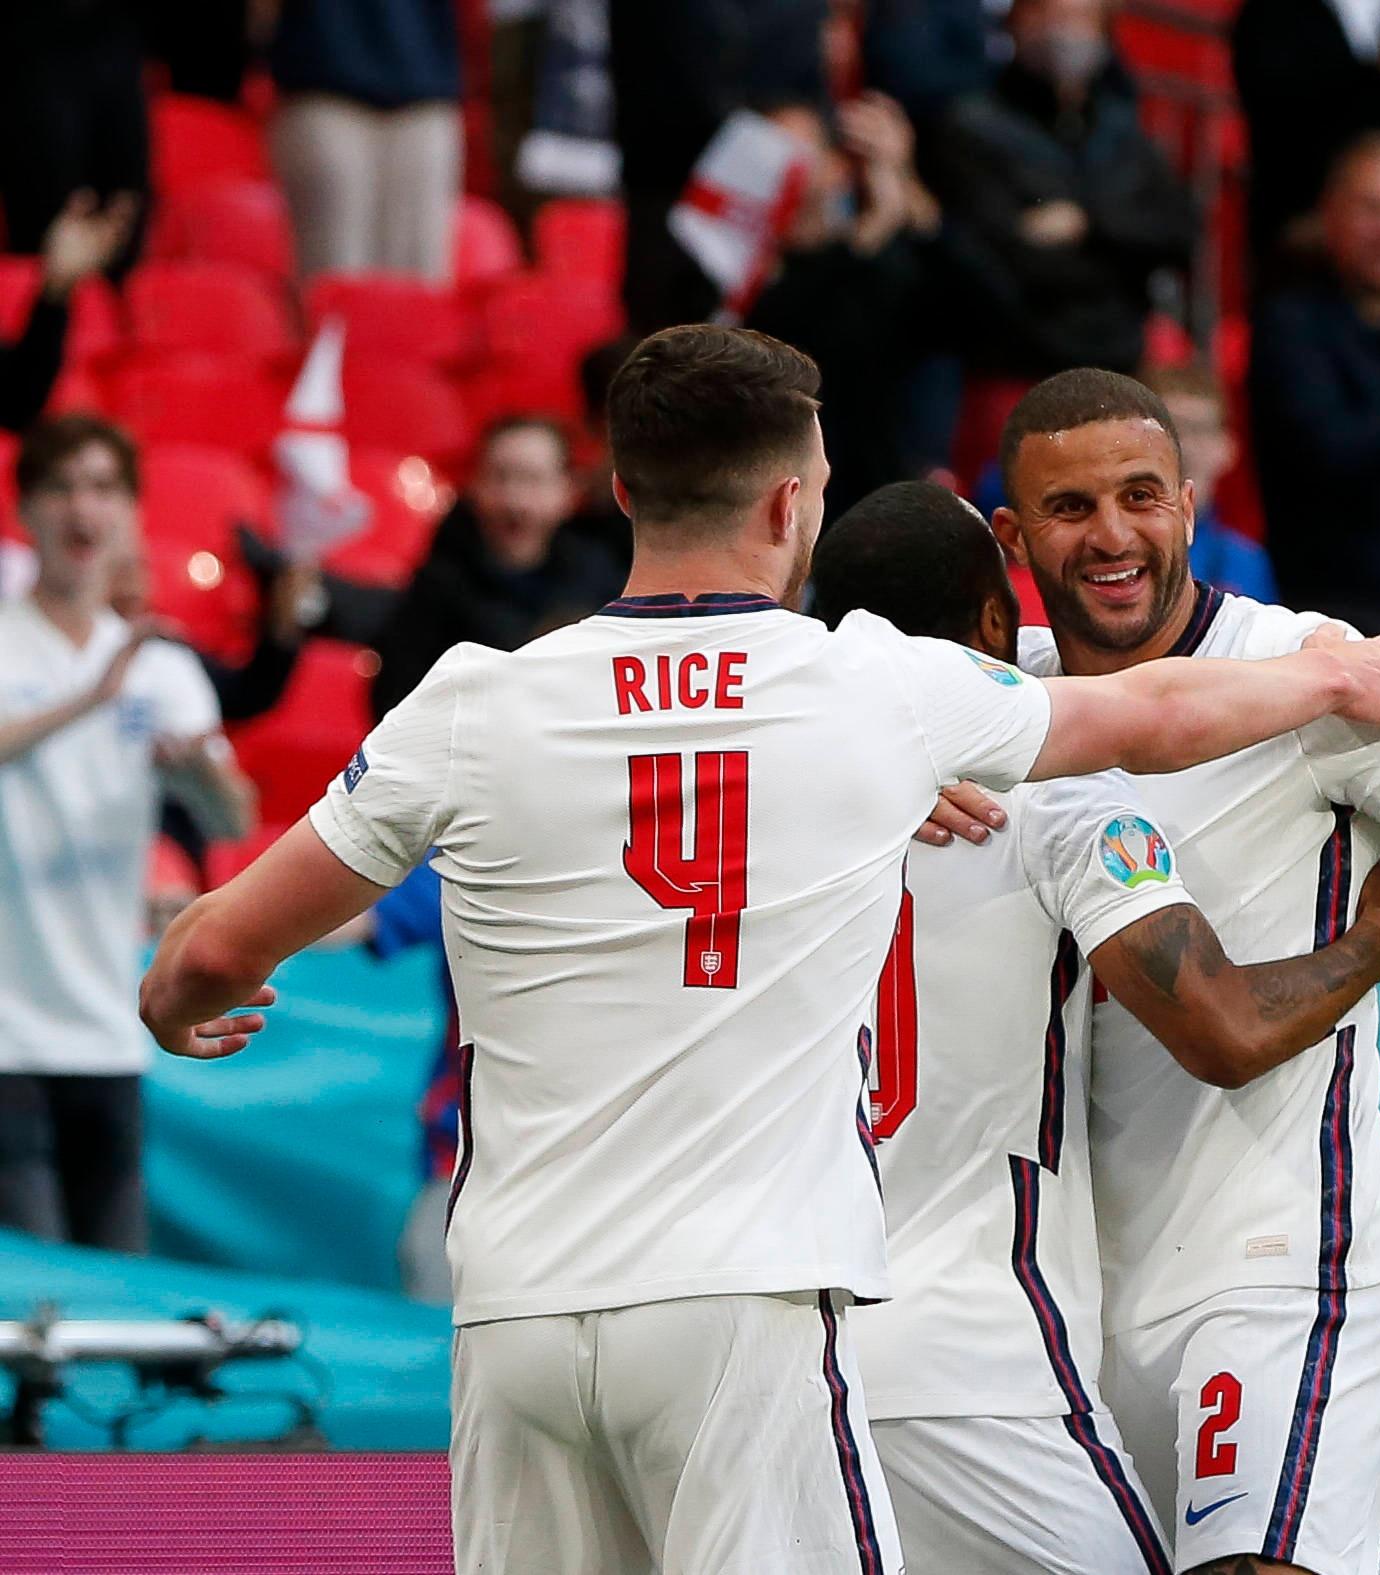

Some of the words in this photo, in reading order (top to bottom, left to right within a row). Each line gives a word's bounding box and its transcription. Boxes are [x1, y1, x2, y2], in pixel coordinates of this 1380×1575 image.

[612, 652, 748, 715] RICE
[623, 750, 749, 988] 4
[1195, 1371, 1243, 1480] 2
